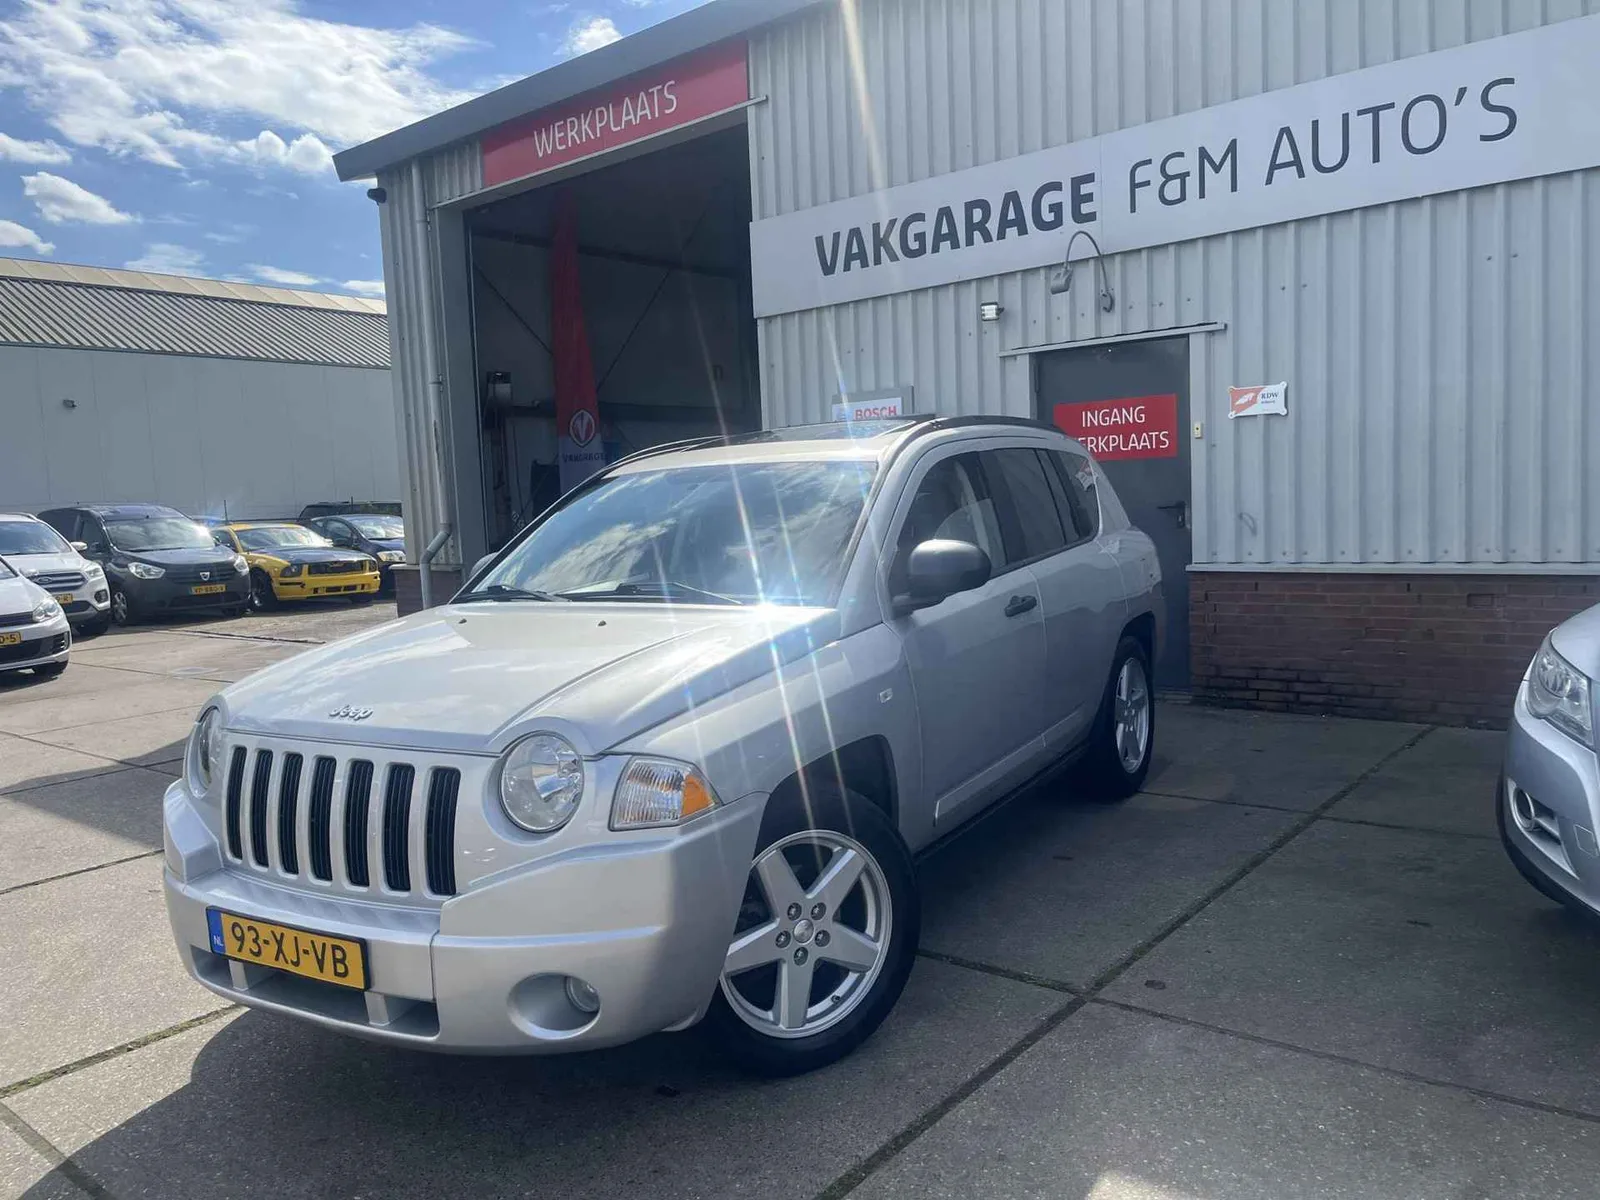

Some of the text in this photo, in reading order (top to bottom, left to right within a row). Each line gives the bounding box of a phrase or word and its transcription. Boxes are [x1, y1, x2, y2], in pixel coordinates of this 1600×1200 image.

[534, 80, 677, 158] WERKPLAATS
[815, 76, 1518, 276] VAKGARAGE F&M AUTO'S
[855, 405, 897, 420] BOSCH
[1082, 405, 1146, 428] INGANG
[1076, 431, 1169, 453] ERKPLAATS
[328, 704, 374, 721] Jeep
[212, 934, 224, 947] NL
[231, 922, 350, 979] 93-XJ-VB
